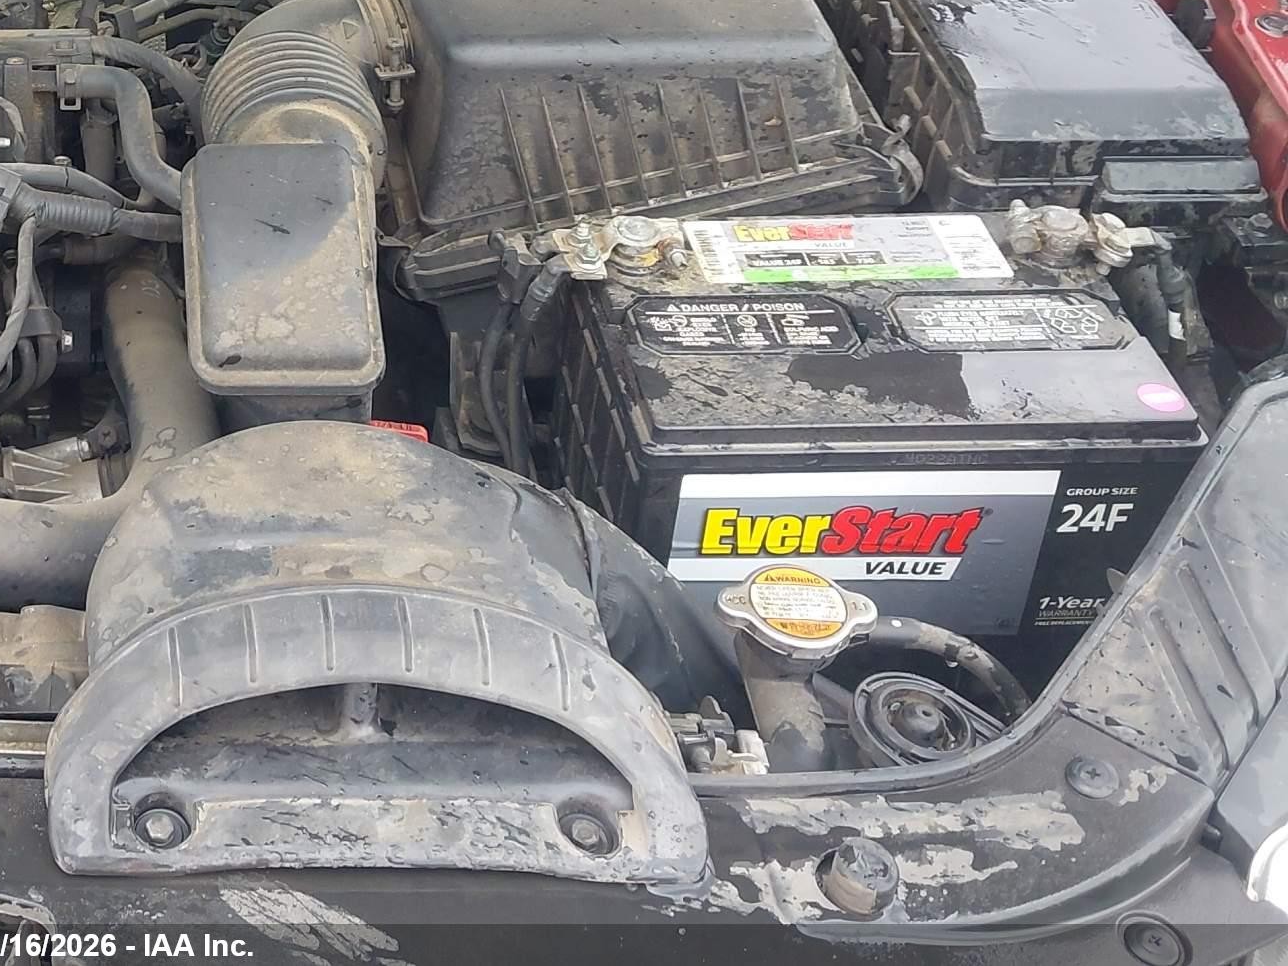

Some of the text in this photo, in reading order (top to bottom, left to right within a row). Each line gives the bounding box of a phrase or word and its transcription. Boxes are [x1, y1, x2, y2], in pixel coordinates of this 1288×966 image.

[733, 224, 854, 243] EverStart
[681, 303, 739, 312] DANGER
[753, 302, 805, 311] POISON
[1066, 487, 1139, 496] GROUP SIZE
[1056, 503, 1134, 533] 24F
[699, 506, 985, 555] EverStart
[865, 561, 947, 575] VALUE
[775, 576, 821, 584] WARNING
[1039, 596, 1105, 610] 1-Year
[1038, 609, 1094, 617] WARRANTY
